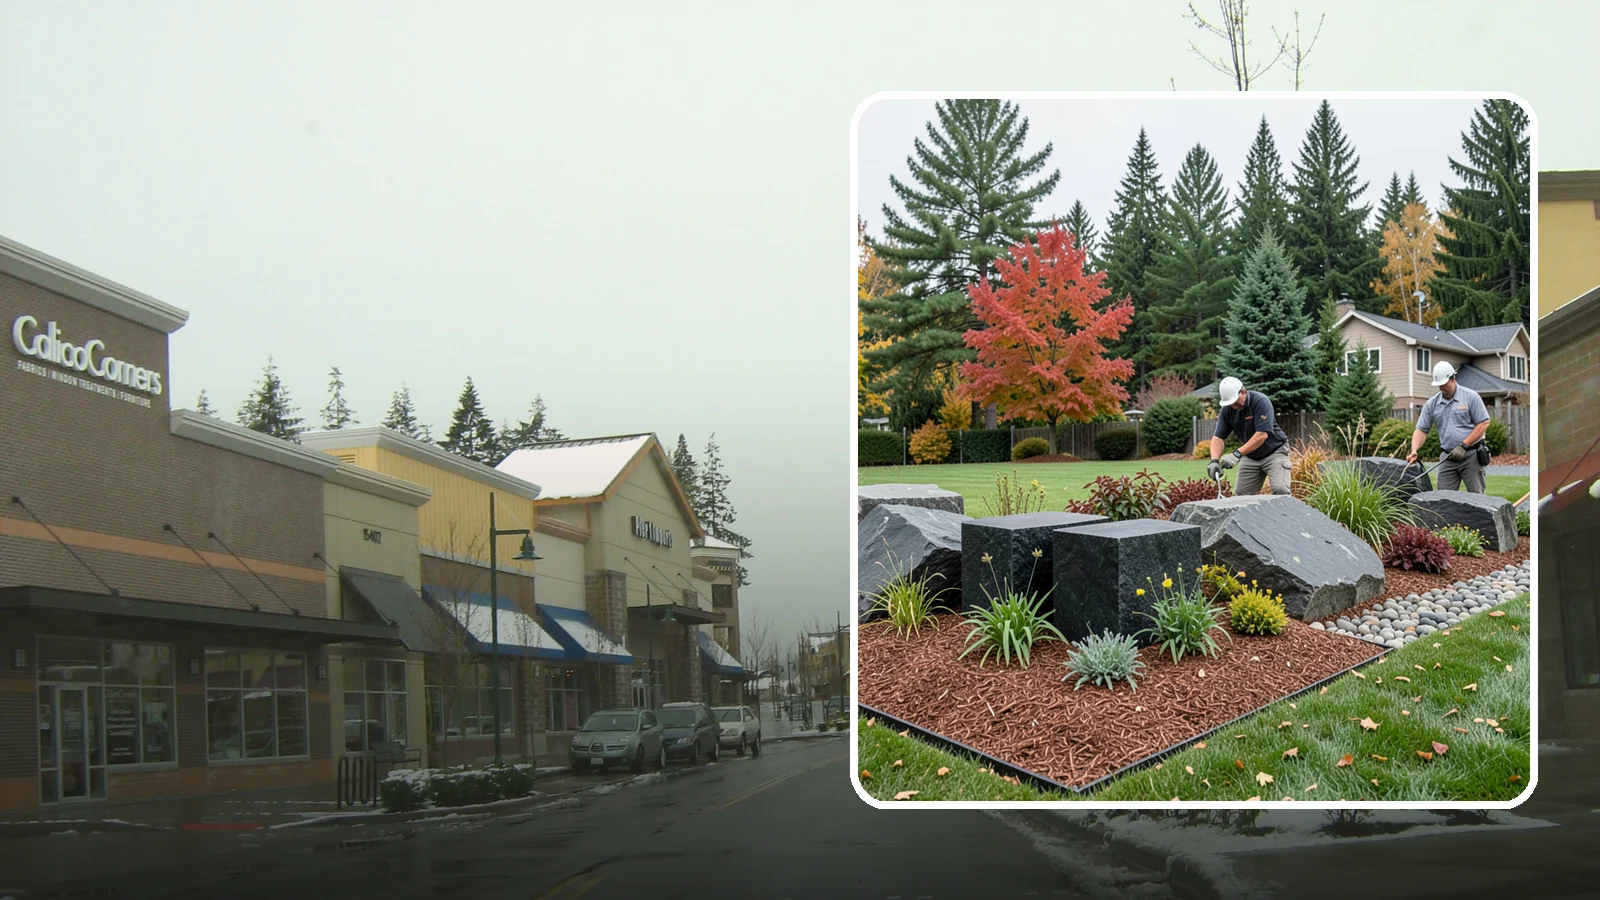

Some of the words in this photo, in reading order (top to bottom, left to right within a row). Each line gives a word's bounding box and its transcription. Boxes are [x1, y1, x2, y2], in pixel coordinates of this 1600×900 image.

[16, 359, 47, 378] FABRICS
[51, 369, 78, 387] WINDOW
[79, 378, 117, 398] TREATMENTS
[120, 391, 152, 409] FURNITURE
